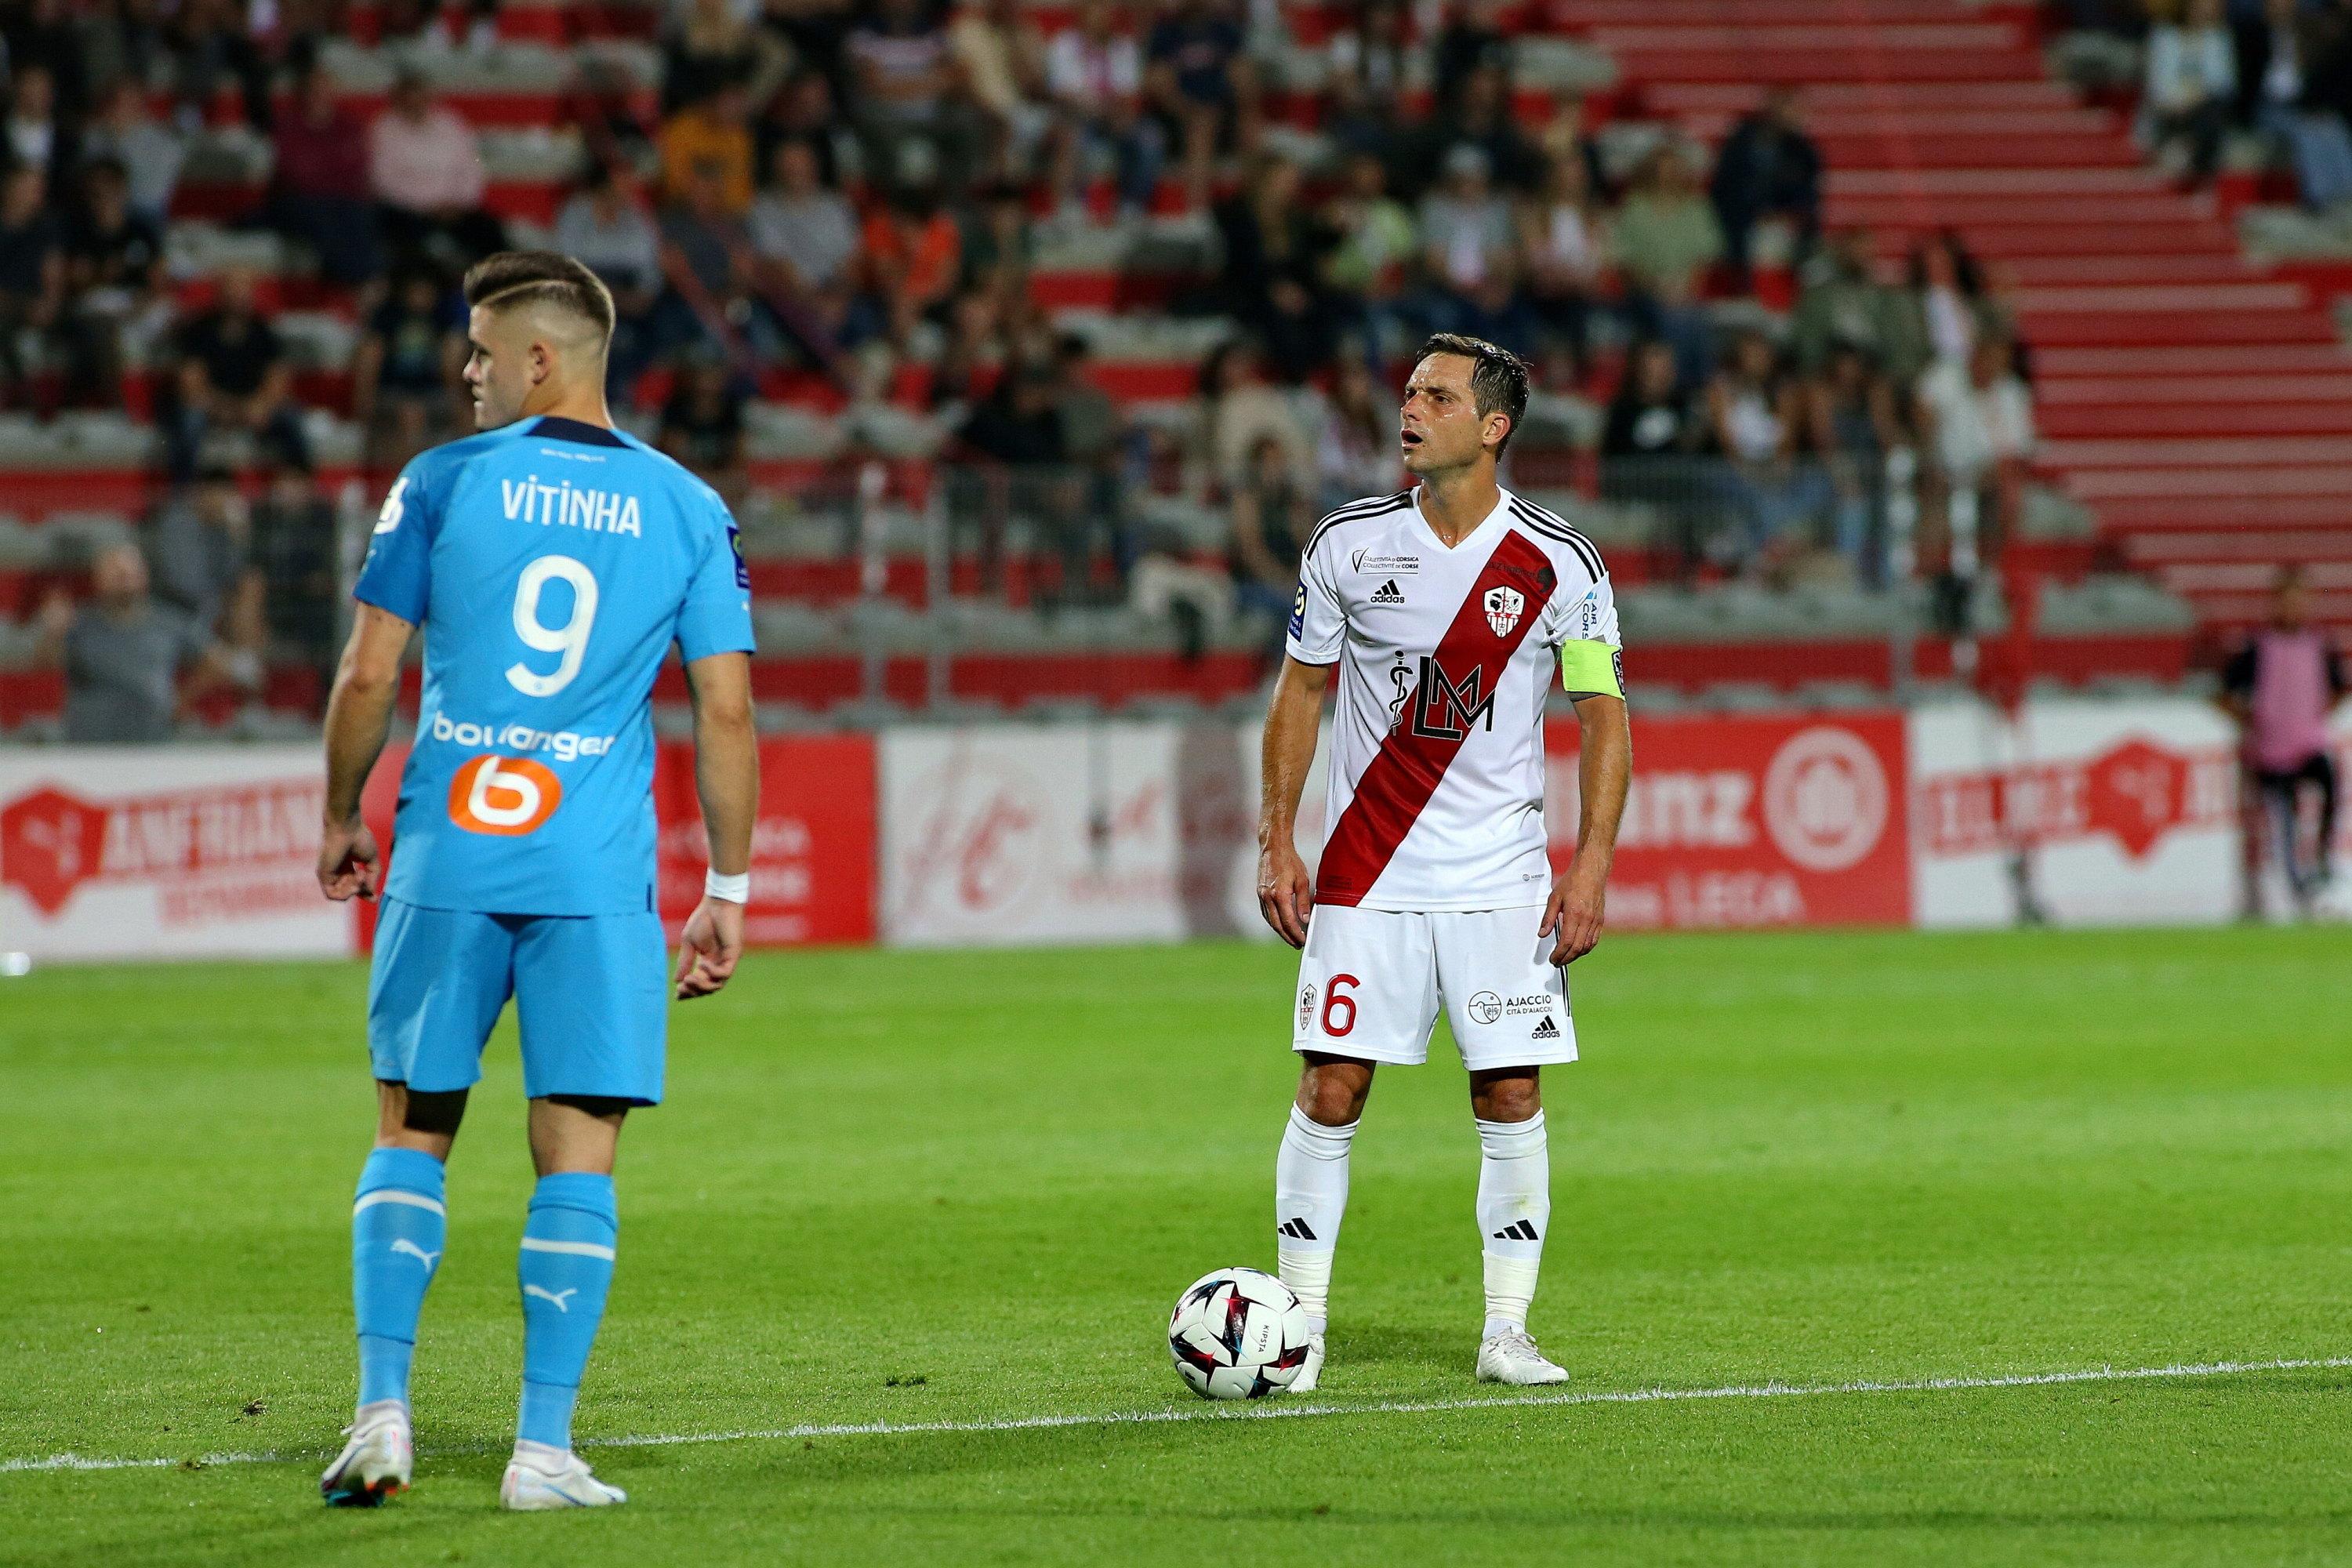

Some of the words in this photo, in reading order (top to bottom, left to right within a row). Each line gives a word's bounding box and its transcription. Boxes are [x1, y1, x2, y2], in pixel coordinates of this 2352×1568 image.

[1370, 593, 1405, 604] adidas
[505, 554, 599, 698] 9
[1320, 974, 1360, 1037] 6
[1506, 994, 1552, 1007] AJACCIO
[1506, 1007, 1522, 1015] CITÀ
[1531, 1030, 1561, 1040] adidas
[1258, 1324, 1269, 1352] KIPSTA
